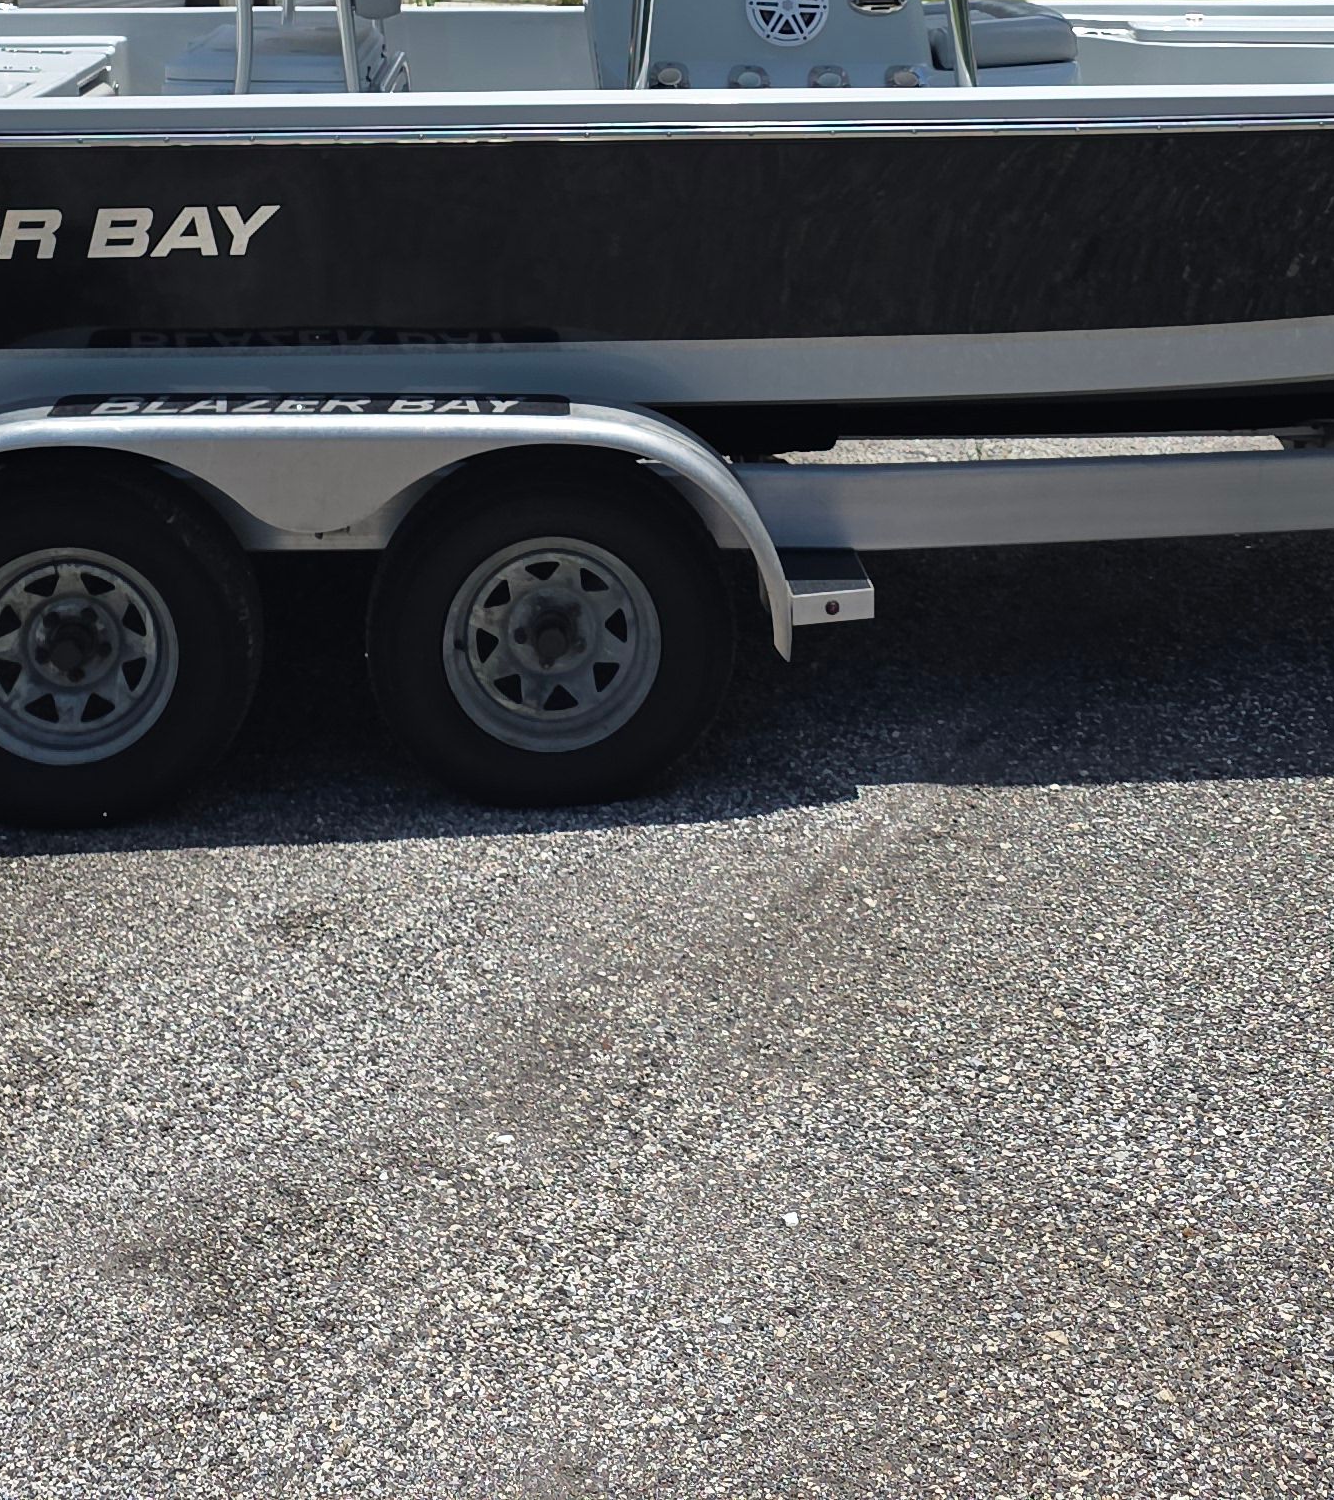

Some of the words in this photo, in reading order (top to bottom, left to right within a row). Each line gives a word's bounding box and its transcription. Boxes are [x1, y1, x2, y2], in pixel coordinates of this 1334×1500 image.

[87, 205, 281, 259] BAY
[91, 396, 372, 415] BLAZER
[387, 396, 523, 413] BAY
